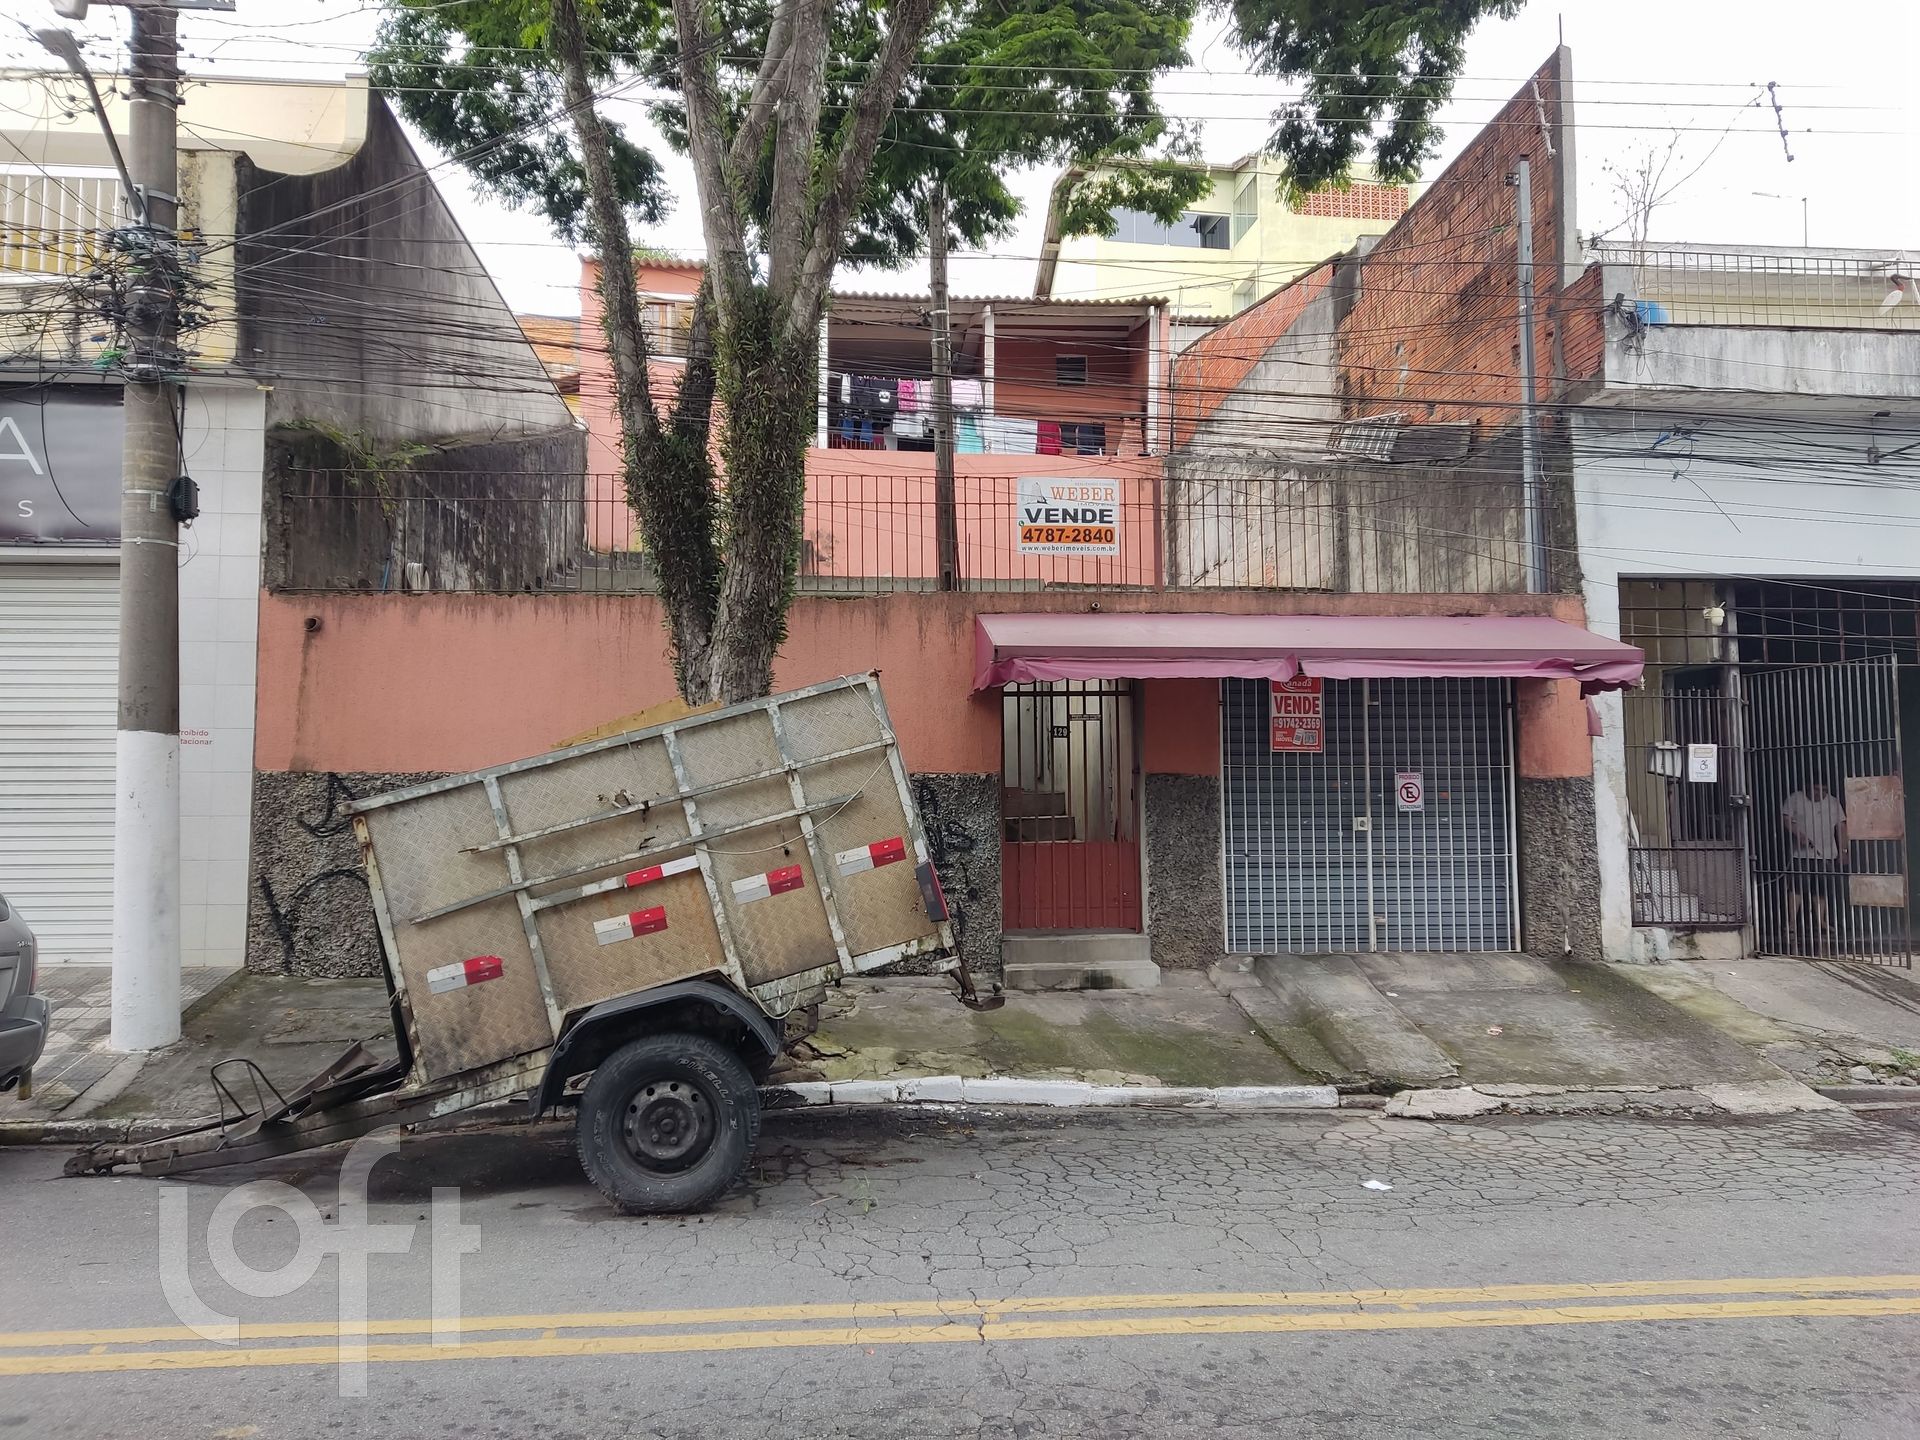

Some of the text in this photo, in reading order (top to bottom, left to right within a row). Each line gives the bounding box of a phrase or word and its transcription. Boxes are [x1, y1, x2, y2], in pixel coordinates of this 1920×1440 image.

[1050, 487, 1115, 502] WEBER
[1025, 508, 1114, 524] VENDE
[1023, 528, 1114, 543] 4787-2840
[1274, 696, 1320, 714] VENDE
[1053, 728, 1067, 736] 129
[677, 1058, 734, 1105] PIRELLI
